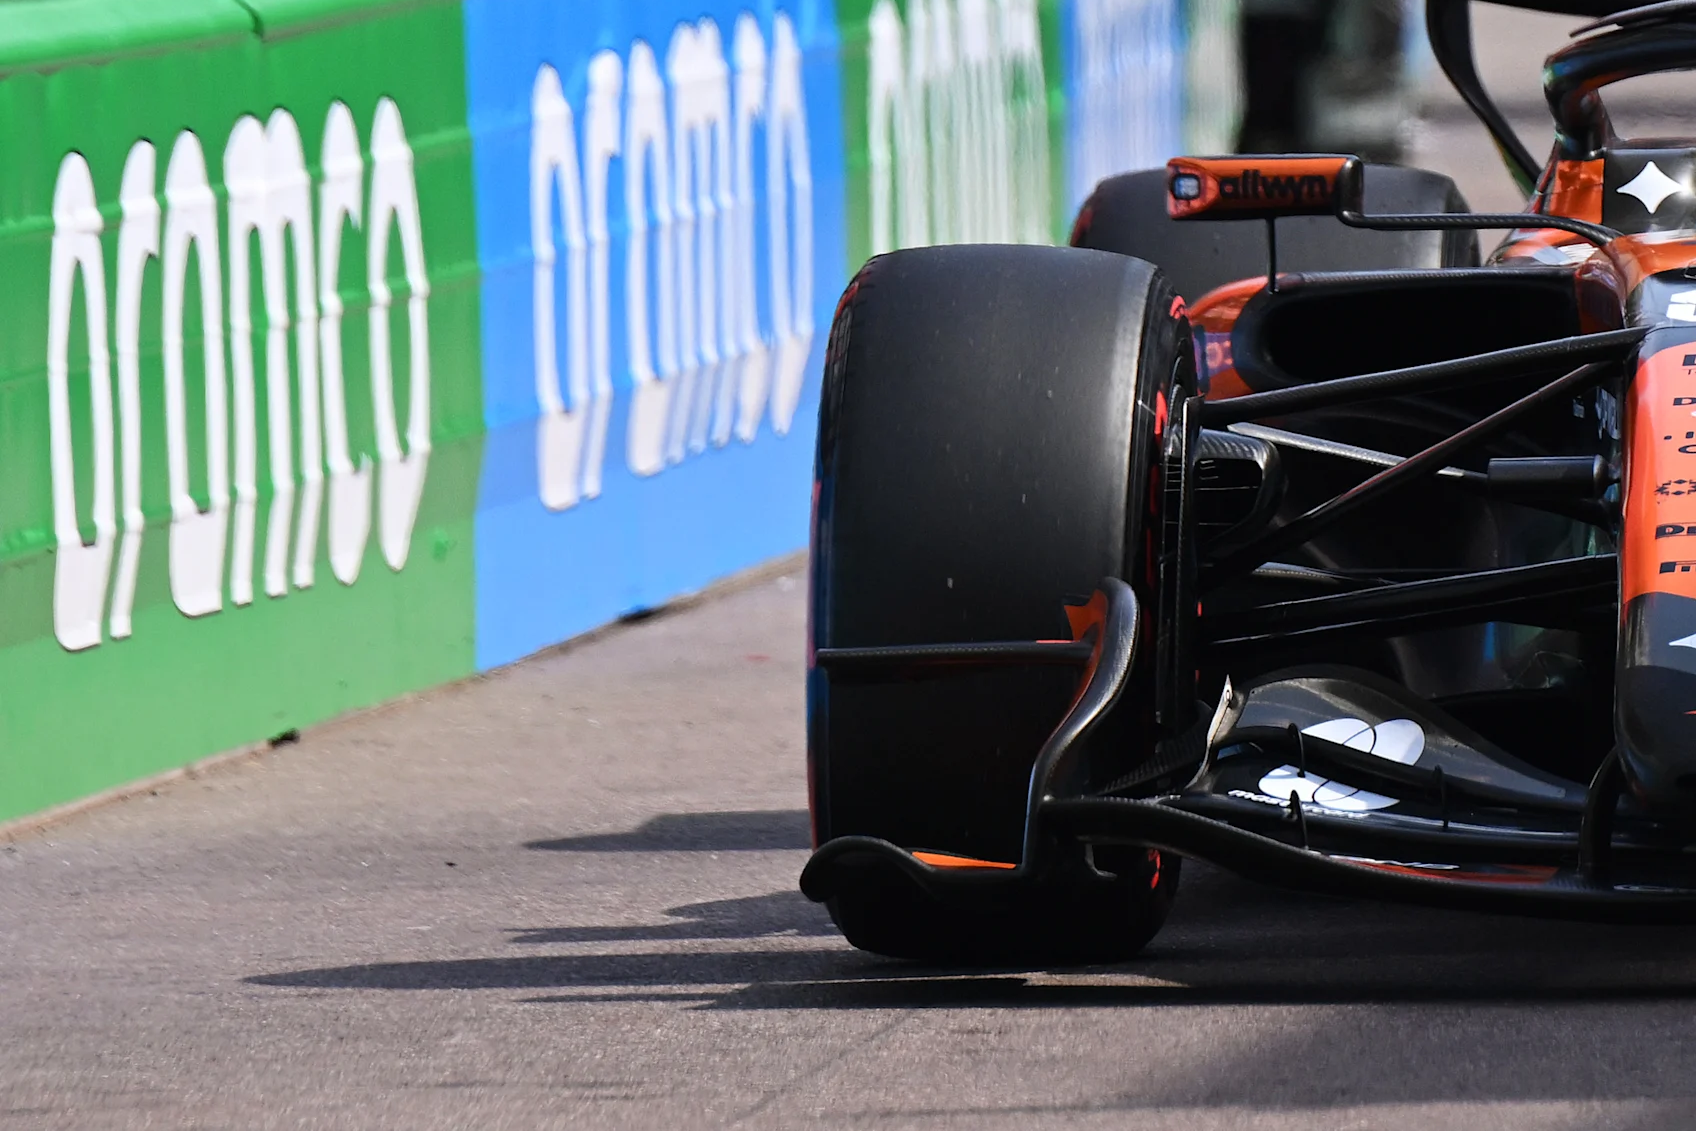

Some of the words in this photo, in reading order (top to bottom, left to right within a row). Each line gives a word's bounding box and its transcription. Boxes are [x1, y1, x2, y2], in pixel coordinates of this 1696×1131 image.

[48, 96, 431, 651] aramco
[530, 9, 814, 512] aramco
[1219, 169, 1328, 203] allwyn
